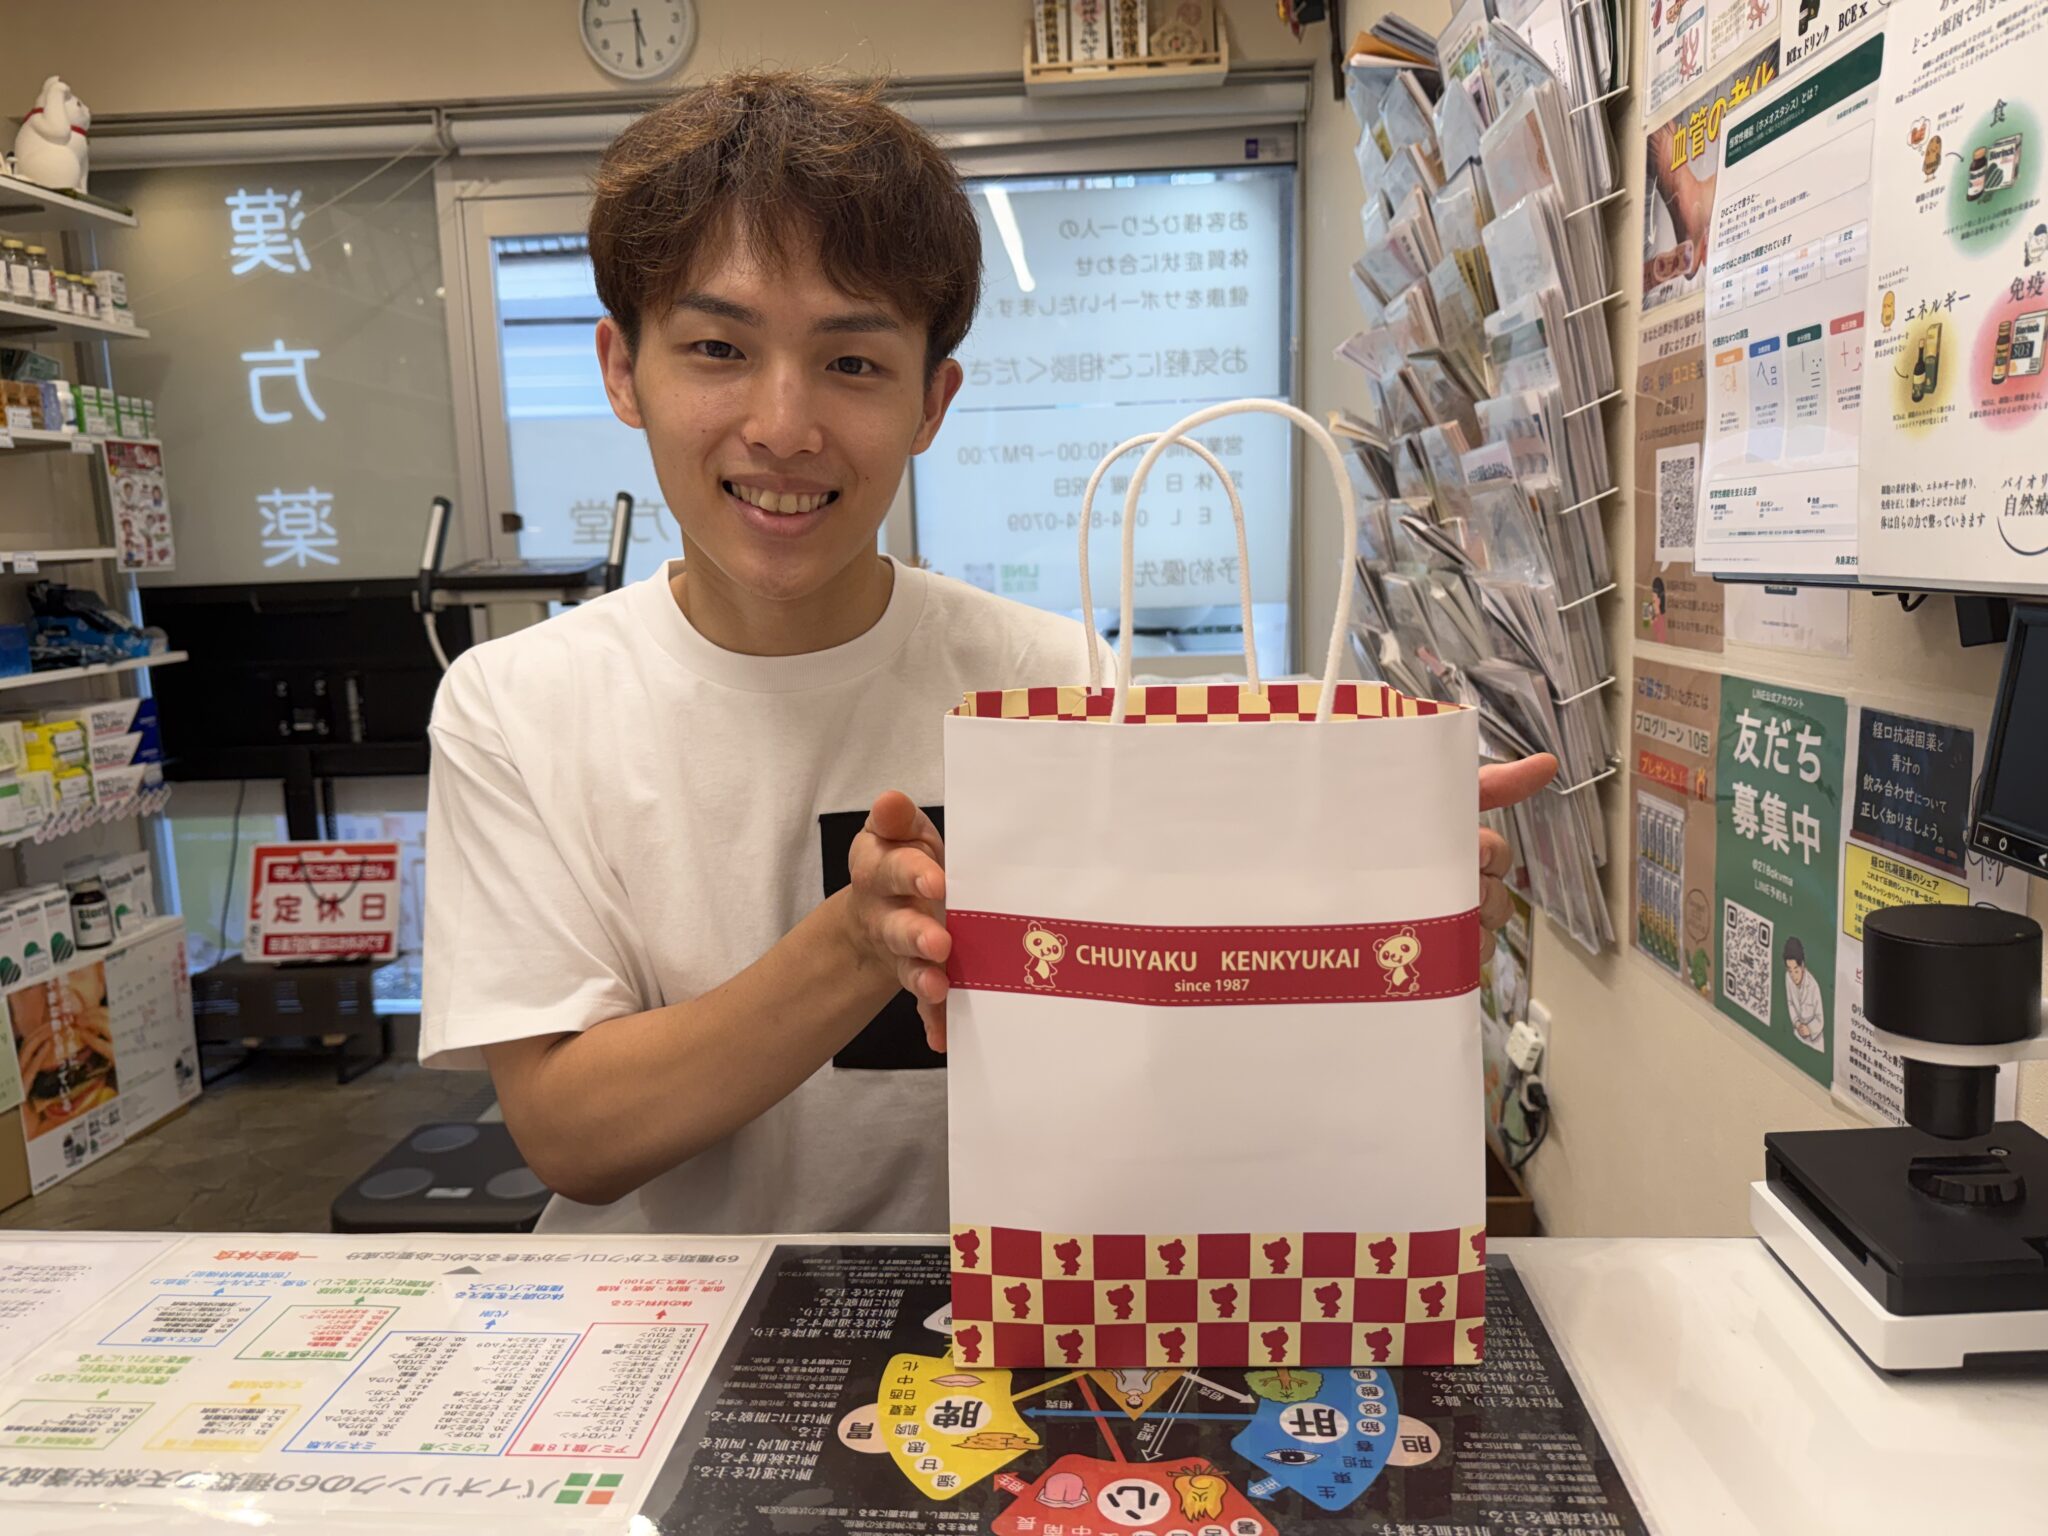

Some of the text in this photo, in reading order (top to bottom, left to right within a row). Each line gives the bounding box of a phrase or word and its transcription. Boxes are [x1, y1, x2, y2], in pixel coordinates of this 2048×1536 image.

[1990, 98, 2008, 128] 食
[2008, 271, 2047, 304] 免疫
[1904, 290, 1970, 322] エネルギー
[1880, 512, 1986, 530] 体は自らの力で整っていきます
[1636, 714, 1710, 755] プログリーン 10包
[1872, 721, 1944, 753] 経口抗凝固薬と
[1733, 708, 1822, 783] 友だち
[1891, 753, 1921, 776] 青汁の
[1863, 773, 1947, 814] 飲み合わせについて
[1732, 781, 1821, 865] 募集中
[1860, 801, 1943, 843] 正しく知りましょう。
[1871, 856, 1939, 891] 経口抗凝固薬のシェア
[273, 893, 386, 924] 定休日
[1075, 943, 1360, 973] CHUIYAKU KENKYUKAI
[1174, 978, 1250, 994] since 1987
[789, 1317, 895, 1327] 水道を通調する。
[902, 1361, 919, 1371] 化
[897, 1375, 913, 1384] 中
[1197, 1386, 1225, 1401] 相克
[1360, 1386, 1379, 1396] 酸
[888, 1404, 917, 1416] 長夏
[1045, 1399, 1073, 1410] 相克
[1363, 1404, 1382, 1415] 怒
[932, 1400, 983, 1429] 脾
[894, 1424, 919, 1436] 肌肉
[1288, 1408, 1338, 1437] 肝
[1360, 1421, 1380, 1433] 筋
[791, 1426, 828, 1438] 主る。
[845, 1422, 874, 1440] 胃
[1136, 1422, 1158, 1442] 相克
[698, 1437, 824, 1452] 脾は肌肉・四肢を
[907, 1441, 926, 1453] 思
[1000, 1437, 1013, 1448] 土
[1354, 1440, 1374, 1452] 春
[1400, 1435, 1432, 1453] 胆
[713, 1451, 819, 1466] 脾は統血する。
[920, 1459, 938, 1470] 甘
[1342, 1455, 1373, 1469] 平坦
[693, 1465, 813, 1481] 脾は運化を主る。
[1331, 1471, 1352, 1484] 東
[937, 1475, 956, 1487] 湿
[1316, 1485, 1336, 1500] 生
[1106, 1486, 1160, 1520] 心
[1016, 1515, 1037, 1530] 長
